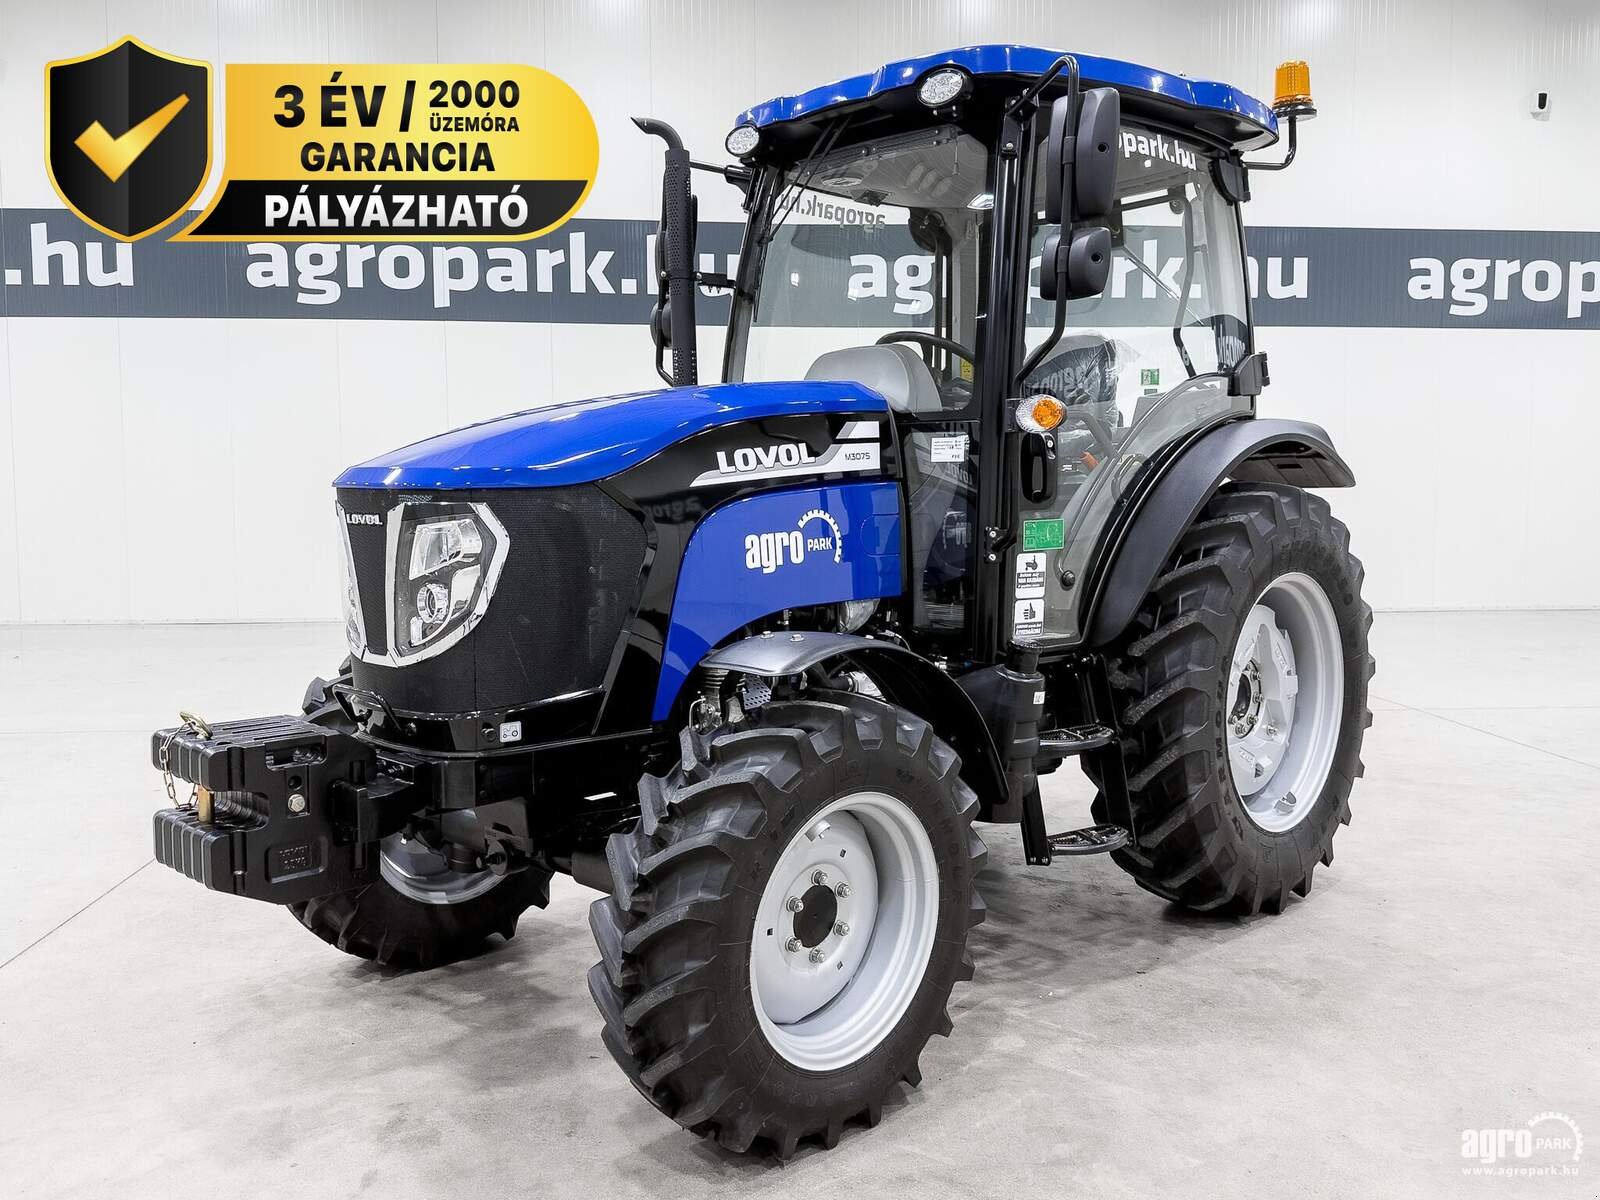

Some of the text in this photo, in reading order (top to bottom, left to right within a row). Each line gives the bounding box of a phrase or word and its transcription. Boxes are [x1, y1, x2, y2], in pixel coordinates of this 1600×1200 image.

[1119, 131, 1197, 171] park.hu
[1406, 256, 1600, 319] agrop
[716, 442, 816, 475] LOVOL
[844, 451, 872, 462] M3075
[345, 512, 383, 526] LOVOL
[744, 529, 833, 575] agro PARK
